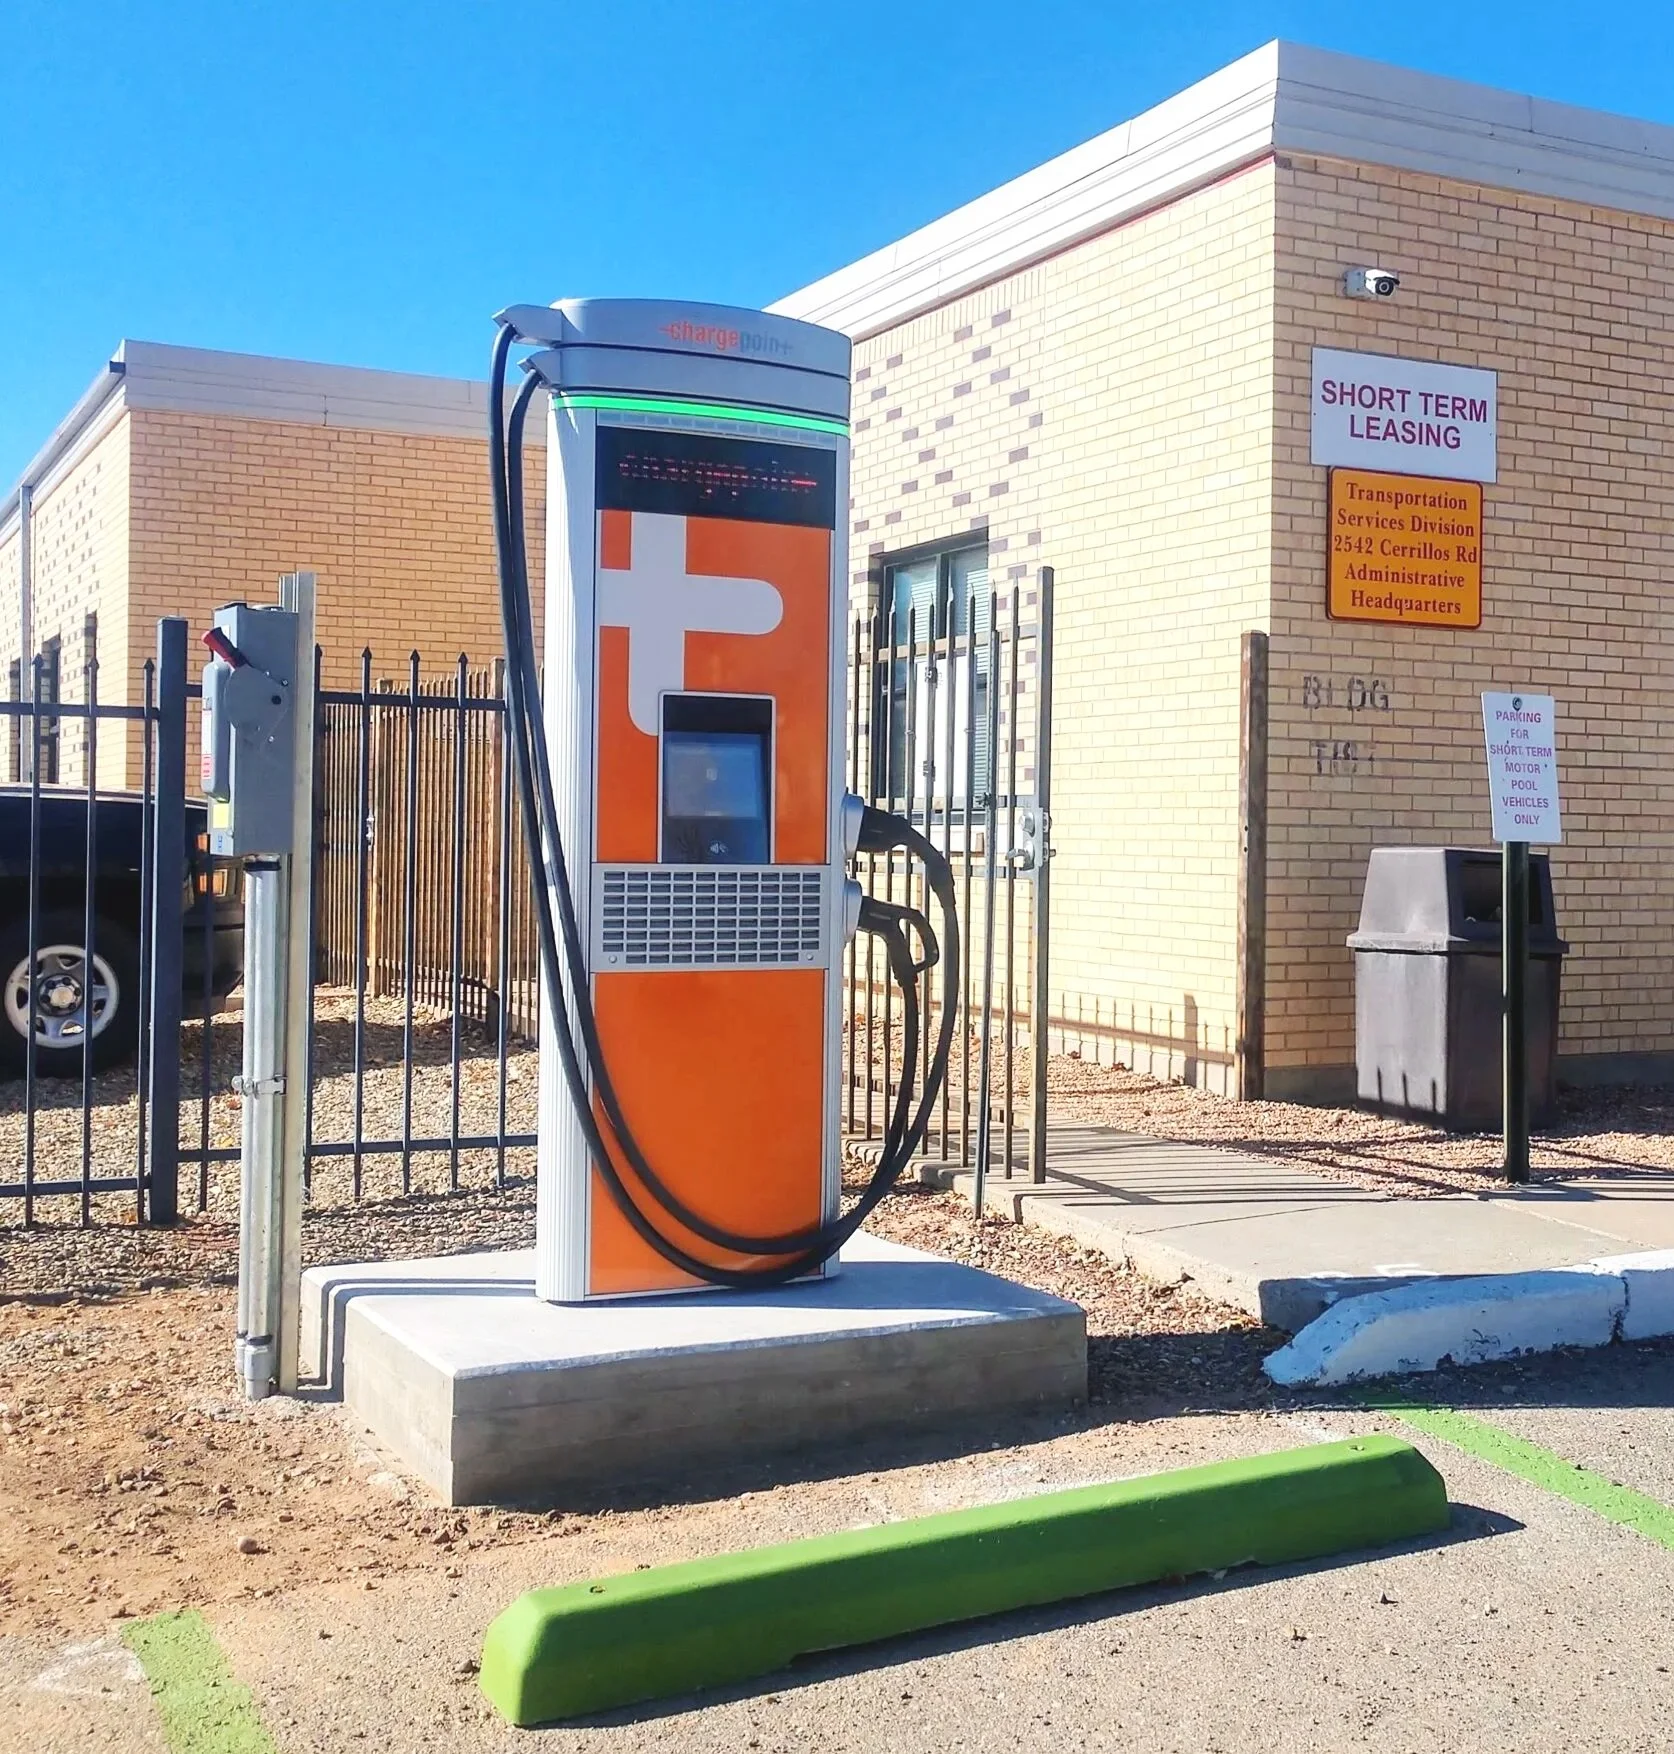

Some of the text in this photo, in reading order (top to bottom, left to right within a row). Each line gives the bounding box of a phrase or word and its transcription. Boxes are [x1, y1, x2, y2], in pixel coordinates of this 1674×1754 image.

[1321, 379, 1487, 423] SHORT TERM
[1350, 414, 1461, 449] LEASING
[1346, 482, 1467, 511] Transportation
[1337, 508, 1475, 537] Services Division
[1334, 535, 1477, 564] 2542 Cerrillos Rd
[1344, 562, 1465, 588] Administrative
[1351, 589, 1461, 616] Headquarters
[1496, 710, 1541, 723] PARKING
[1510, 728, 1530, 740] FOR
[1490, 744, 1552, 758] SHORT TERM
[1505, 762, 1541, 774] MOTOR
[1511, 779, 1538, 791] POOL
[1502, 796, 1549, 808] VEHICLES
[1514, 813, 1540, 825] ONLY
